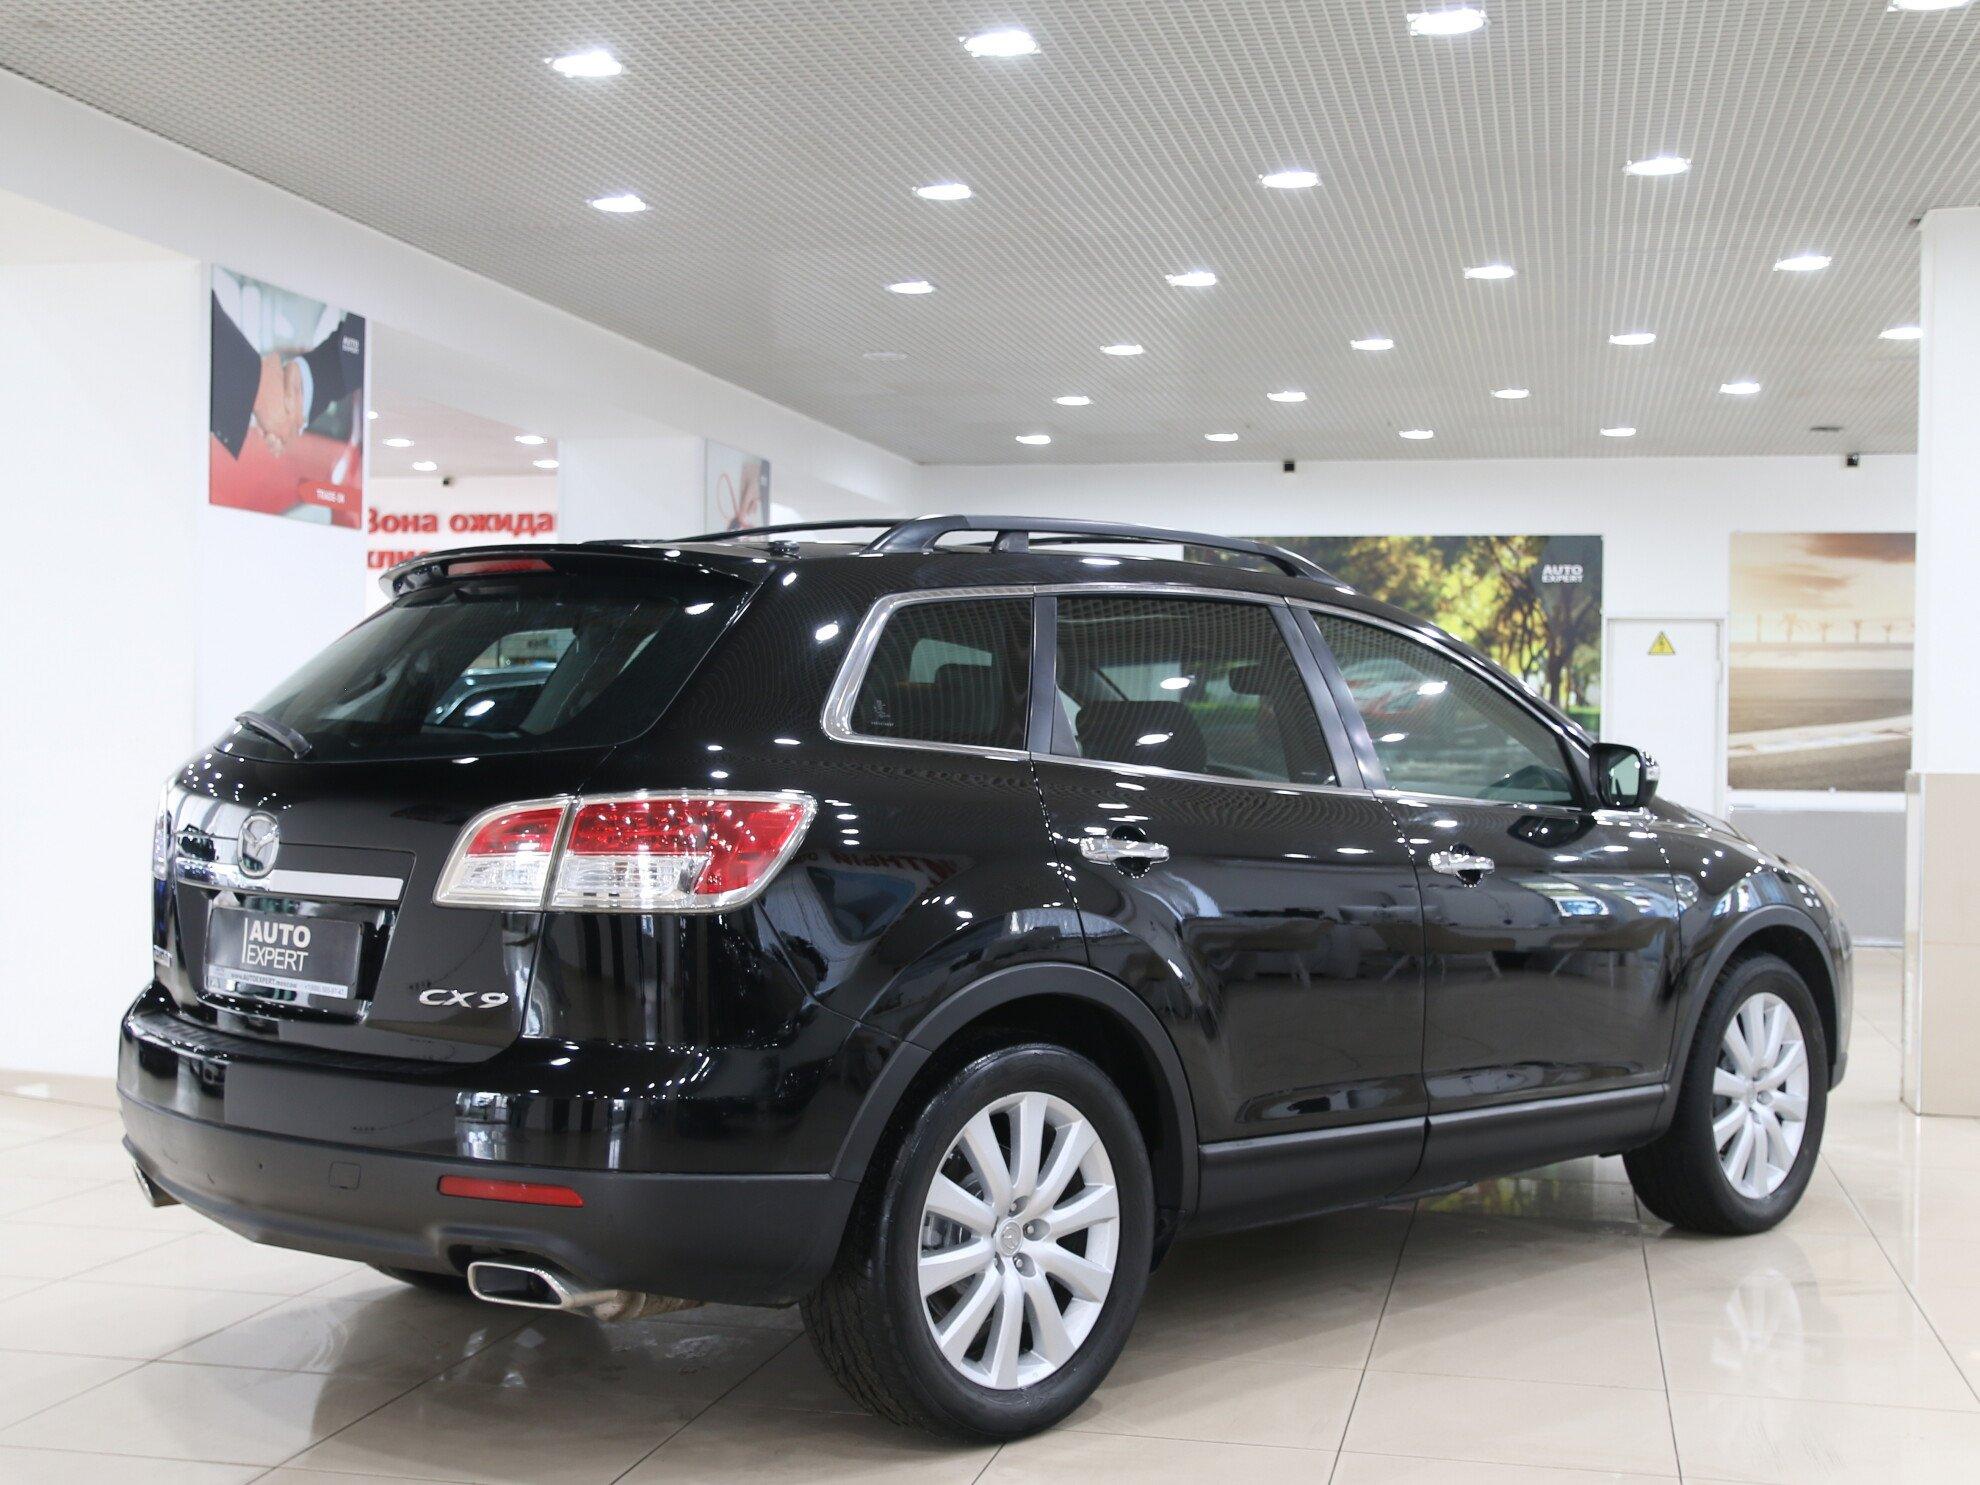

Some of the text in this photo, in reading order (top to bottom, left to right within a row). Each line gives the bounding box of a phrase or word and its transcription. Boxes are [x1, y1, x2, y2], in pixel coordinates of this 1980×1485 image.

[1543, 564, 1583, 576] AUTO
[249, 920, 311, 948] AUTO
[246, 944, 309, 971] EXPERT
